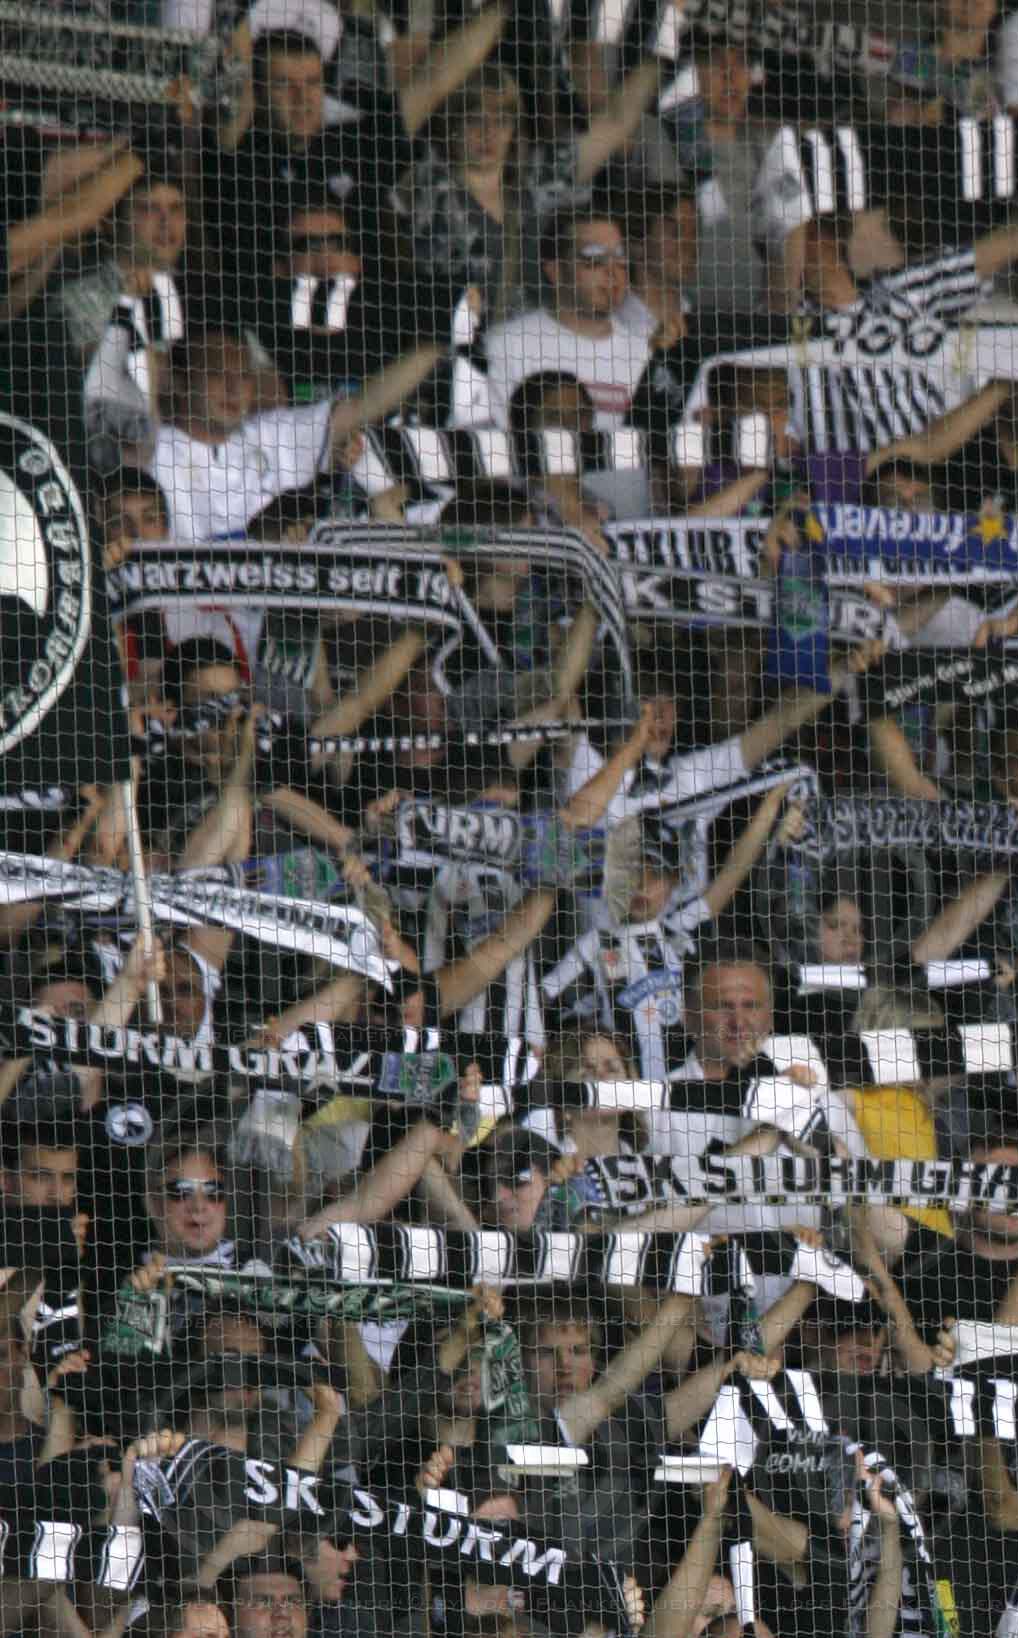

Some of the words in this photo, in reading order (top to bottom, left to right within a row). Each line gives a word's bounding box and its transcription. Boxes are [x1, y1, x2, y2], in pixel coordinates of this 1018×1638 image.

[328, 567, 402, 598] seit
[245, 1459, 325, 1516] SK
[347, 1488, 567, 1586] STURM
